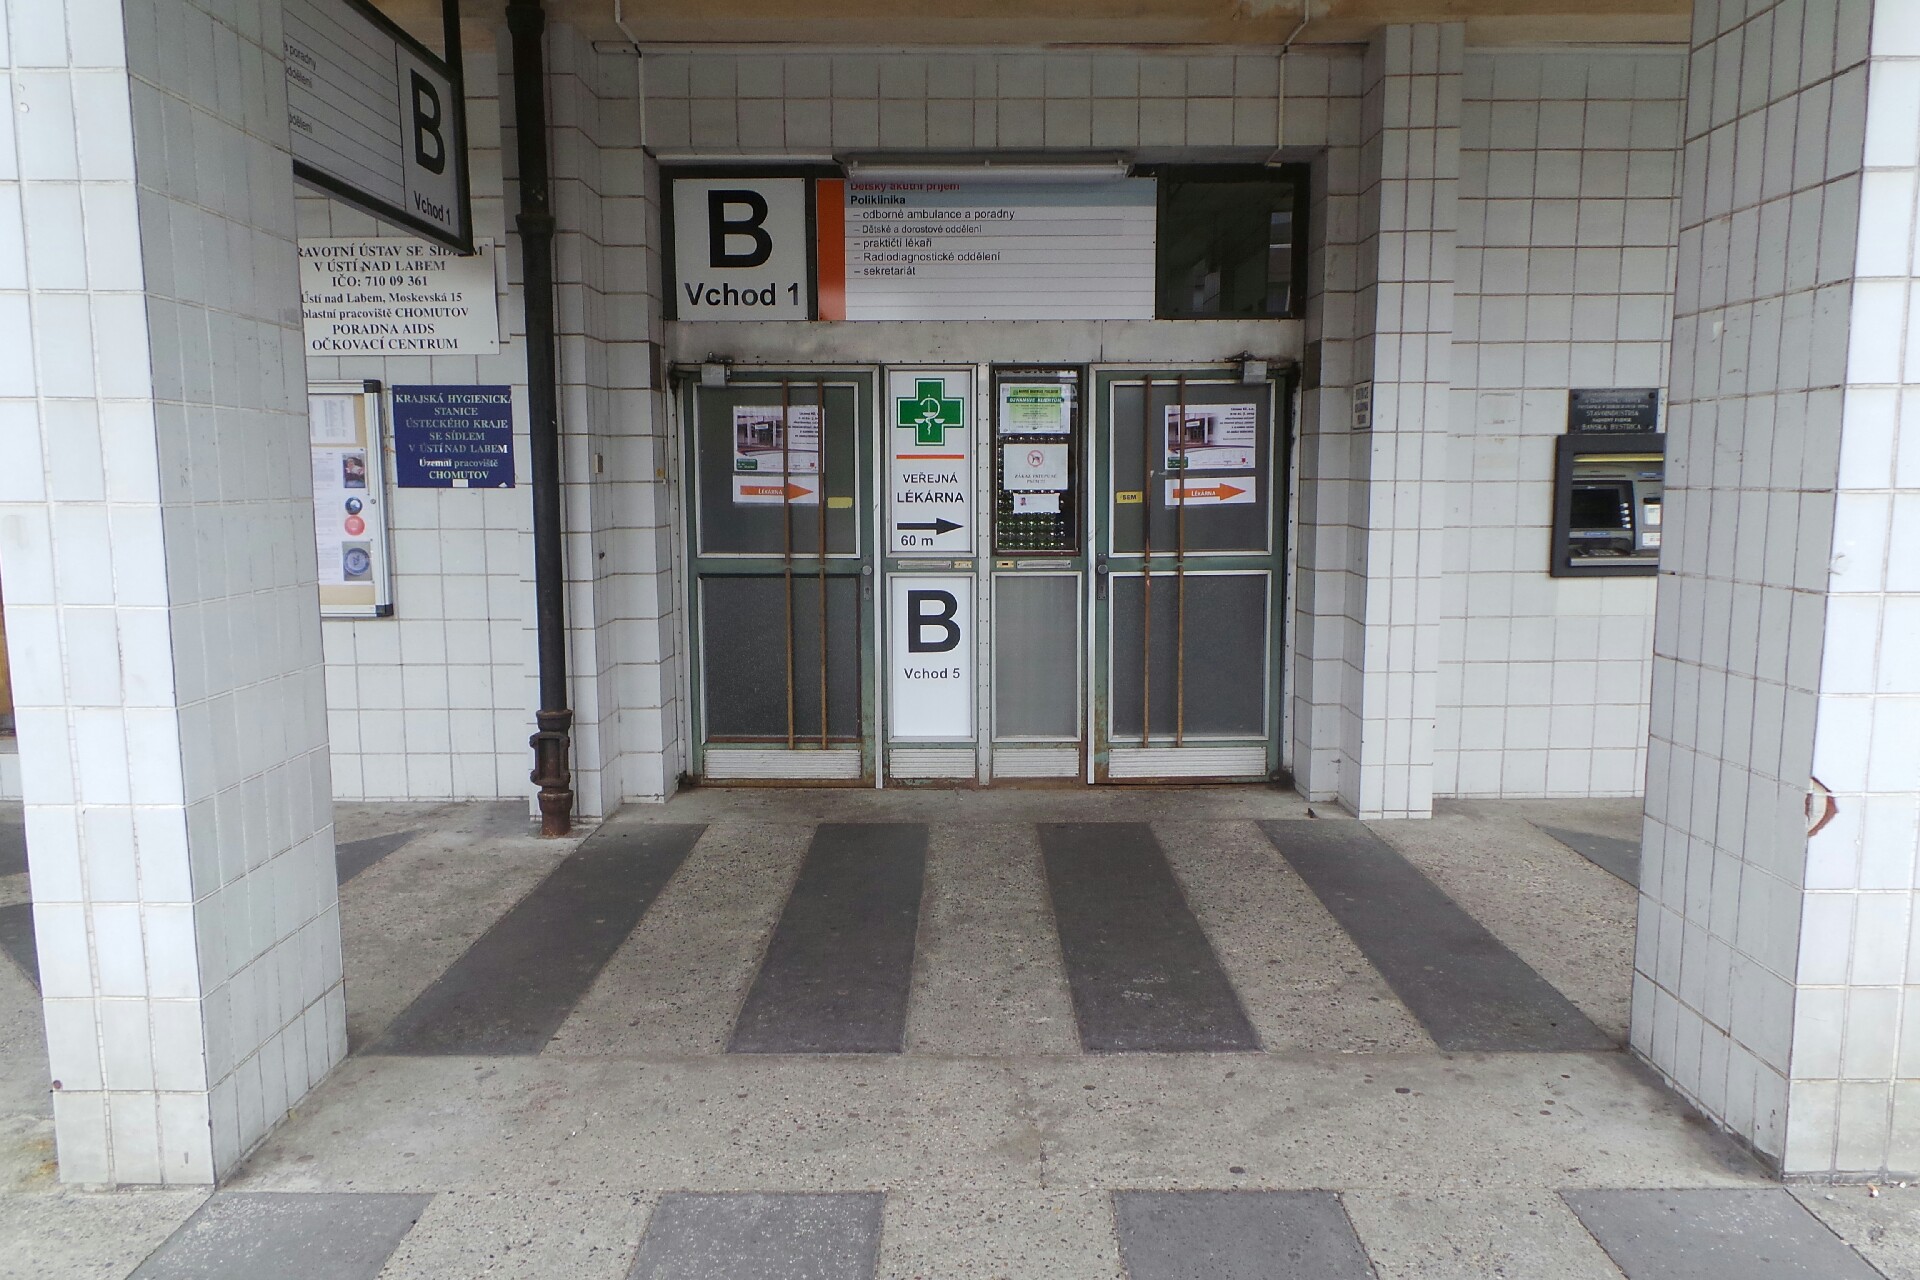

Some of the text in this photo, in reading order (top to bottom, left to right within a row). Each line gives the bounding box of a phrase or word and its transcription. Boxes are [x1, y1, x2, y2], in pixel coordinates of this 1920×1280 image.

[289, 44, 316, 71] poradny
[286, 66, 313, 88] ddělení
[410, 68, 445, 175] B
[850, 195, 906, 205] Poliklinika
[413, 190, 451, 226] Vchod 1
[862, 209, 1015, 221] odborné ambulance a poradny
[708, 190, 773, 267] B
[862, 225, 891, 234] Dětské
[893, 226, 899, 234] a
[901, 225, 944, 234] dorostové
[905, 237, 932, 247] lékaři
[359, 243, 400, 257] ÚSTAV
[406, 246, 424, 257] SE
[863, 251, 1001, 263] Radiodiagnostické oddělení
[314, 258, 445, 272] V ÚSTÍ NAD LABEM
[863, 266, 916, 275] sekretariát
[332, 274, 427, 287] IČO: 710 09 361
[301, 291, 463, 304] Ústí nad Labem, Moskevská 15
[684, 282, 798, 306] Vchod 1
[339, 308, 392, 321] pracoviště
[395, 308, 469, 318] CHOMUTOV
[332, 324, 435, 335] PORADNA AIDS
[312, 336, 458, 350] OČKOVACÍ CENTRUM
[395, 393, 445, 404] KRAJSKÁ
[434, 407, 479, 416] STANICE
[406, 417, 508, 428] ÚSTECKÉHO KRAJE
[429, 430, 485, 441] SE SÍDLEM
[408, 442, 508, 453] V ÚSTÍ NAD LABEM
[419, 457, 499, 469] Územní pracoviště
[429, 471, 489, 479] CHOMUTOV
[902, 471, 958, 484] VEŘEJNÁ
[897, 489, 965, 503] LÉKÁRNA
[901, 535, 934, 546] 60 m
[907, 590, 961, 653] B
[903, 667, 961, 679] Vchod 5
